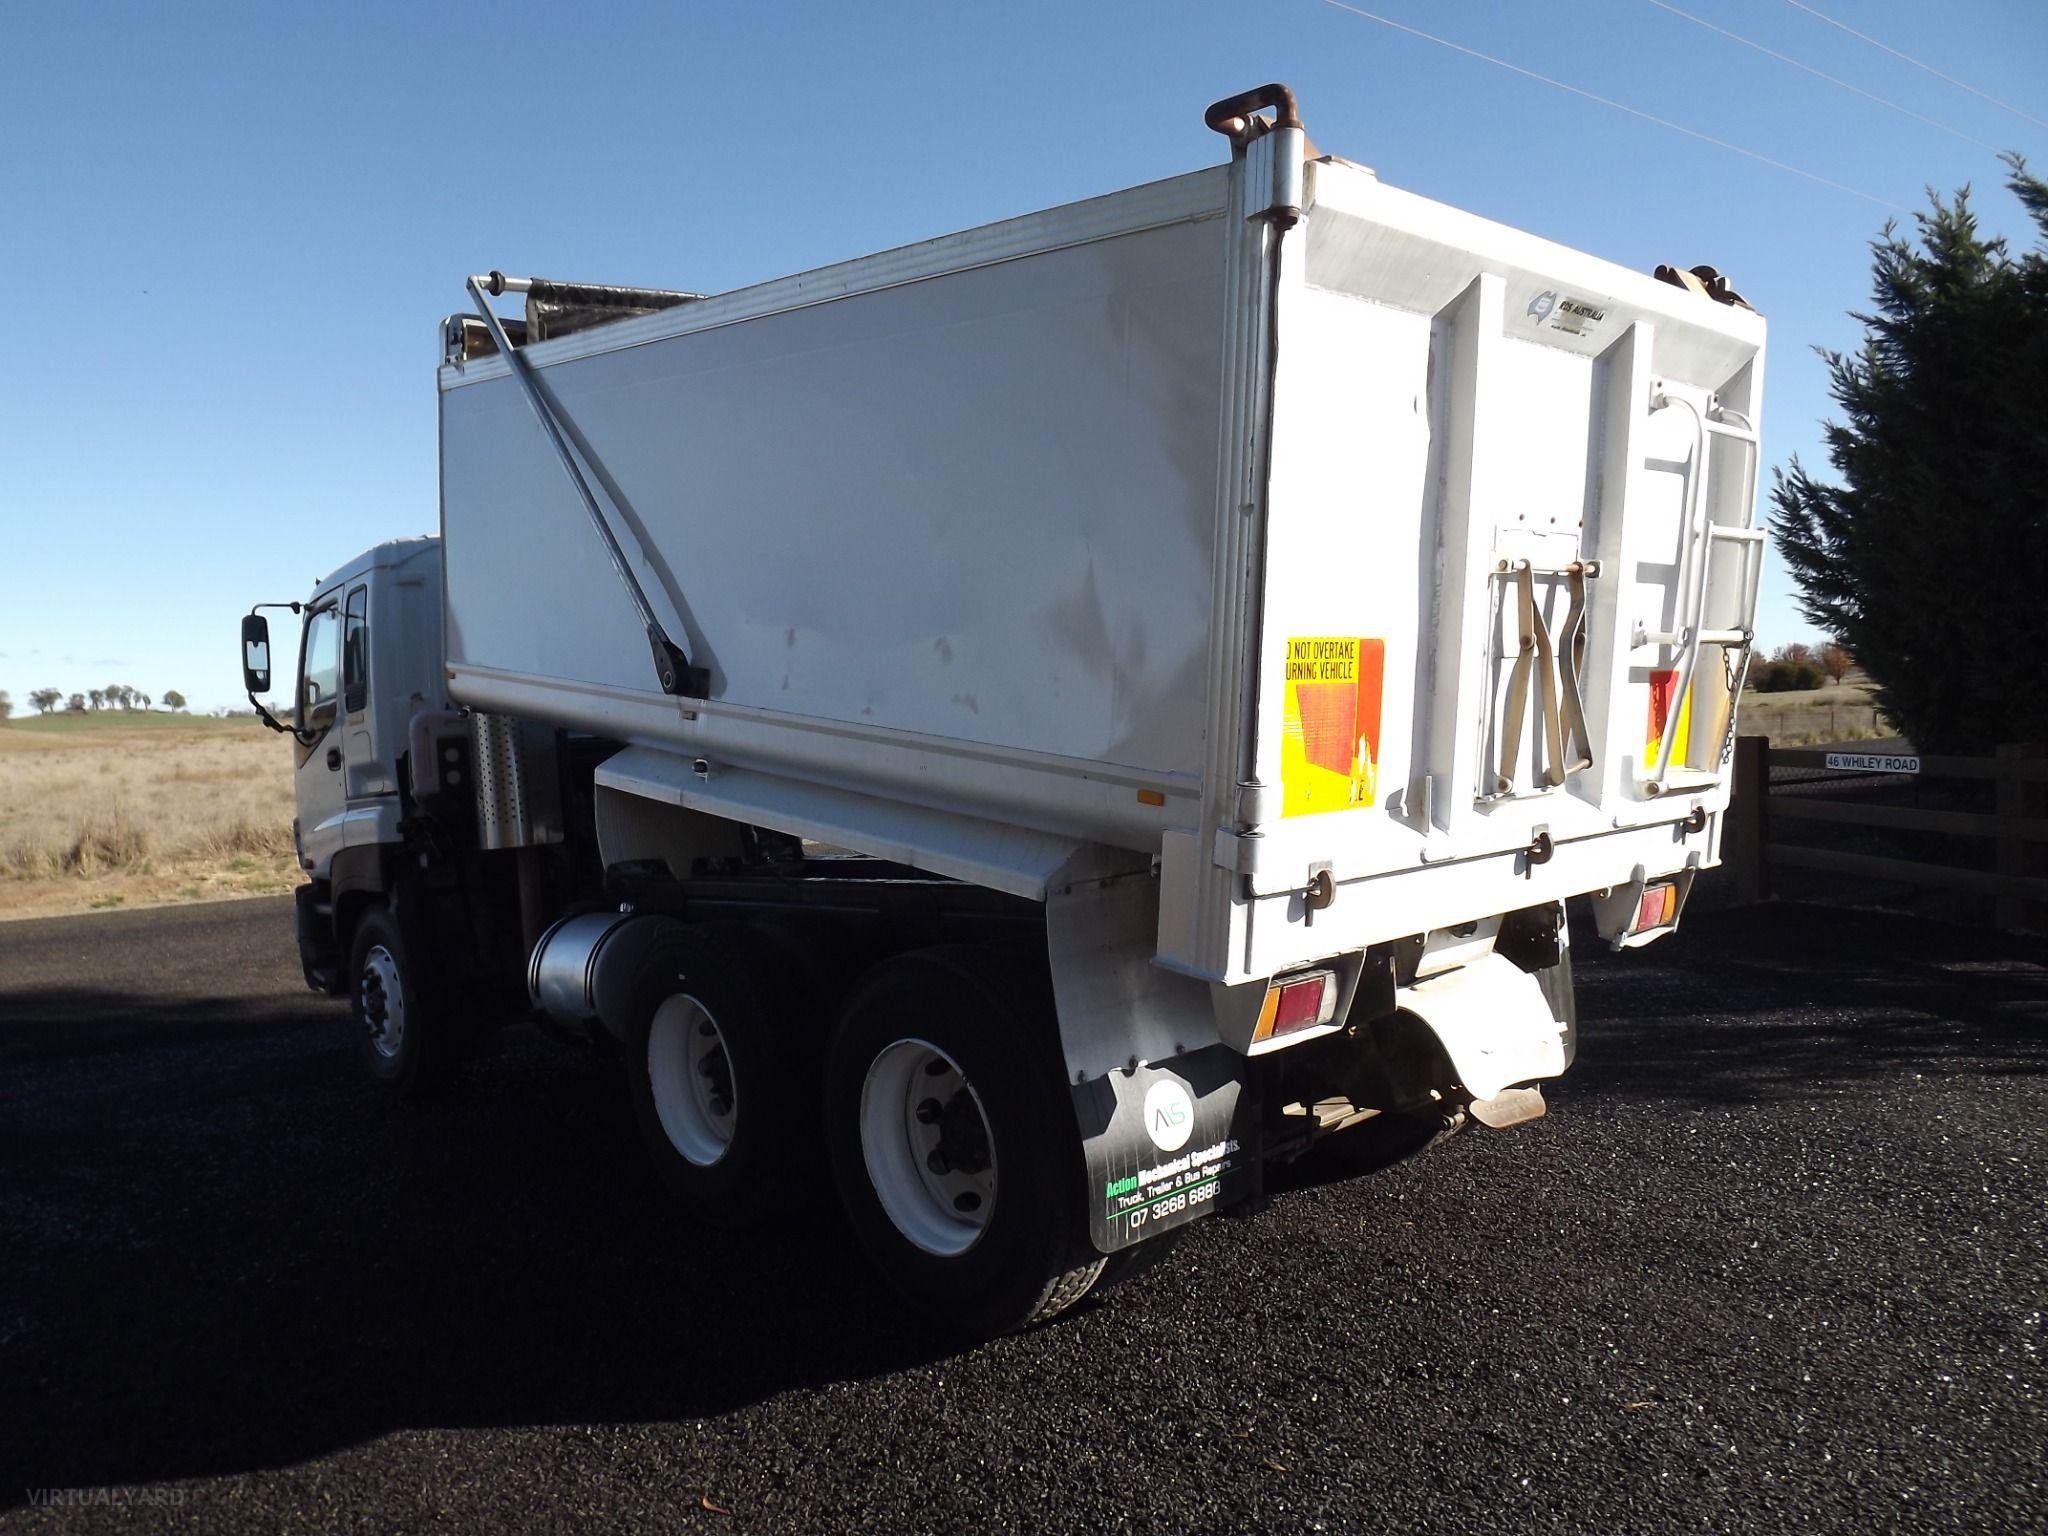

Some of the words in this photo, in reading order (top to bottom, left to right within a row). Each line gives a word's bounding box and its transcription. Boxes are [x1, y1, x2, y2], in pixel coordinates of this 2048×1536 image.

[1573, 304, 1604, 321] AUSTRALIA
[1294, 642, 1311, 660] NOT
[1313, 642, 1355, 660] OVERTAKE
[1285, 662, 1317, 681] URNING
[1320, 662, 1353, 680] VEHICLE
[1827, 756, 1840, 767] 46
[1841, 756, 1881, 769] WHILEY
[1885, 758, 1918, 771] ROAD
[1106, 1175, 1137, 1198] Action
[1175, 1176, 1183, 1188] &
[1184, 1171, 1201, 1184] Bus
[1130, 1207, 1149, 1228] 07
[1152, 1193, 1186, 1220] 3268
